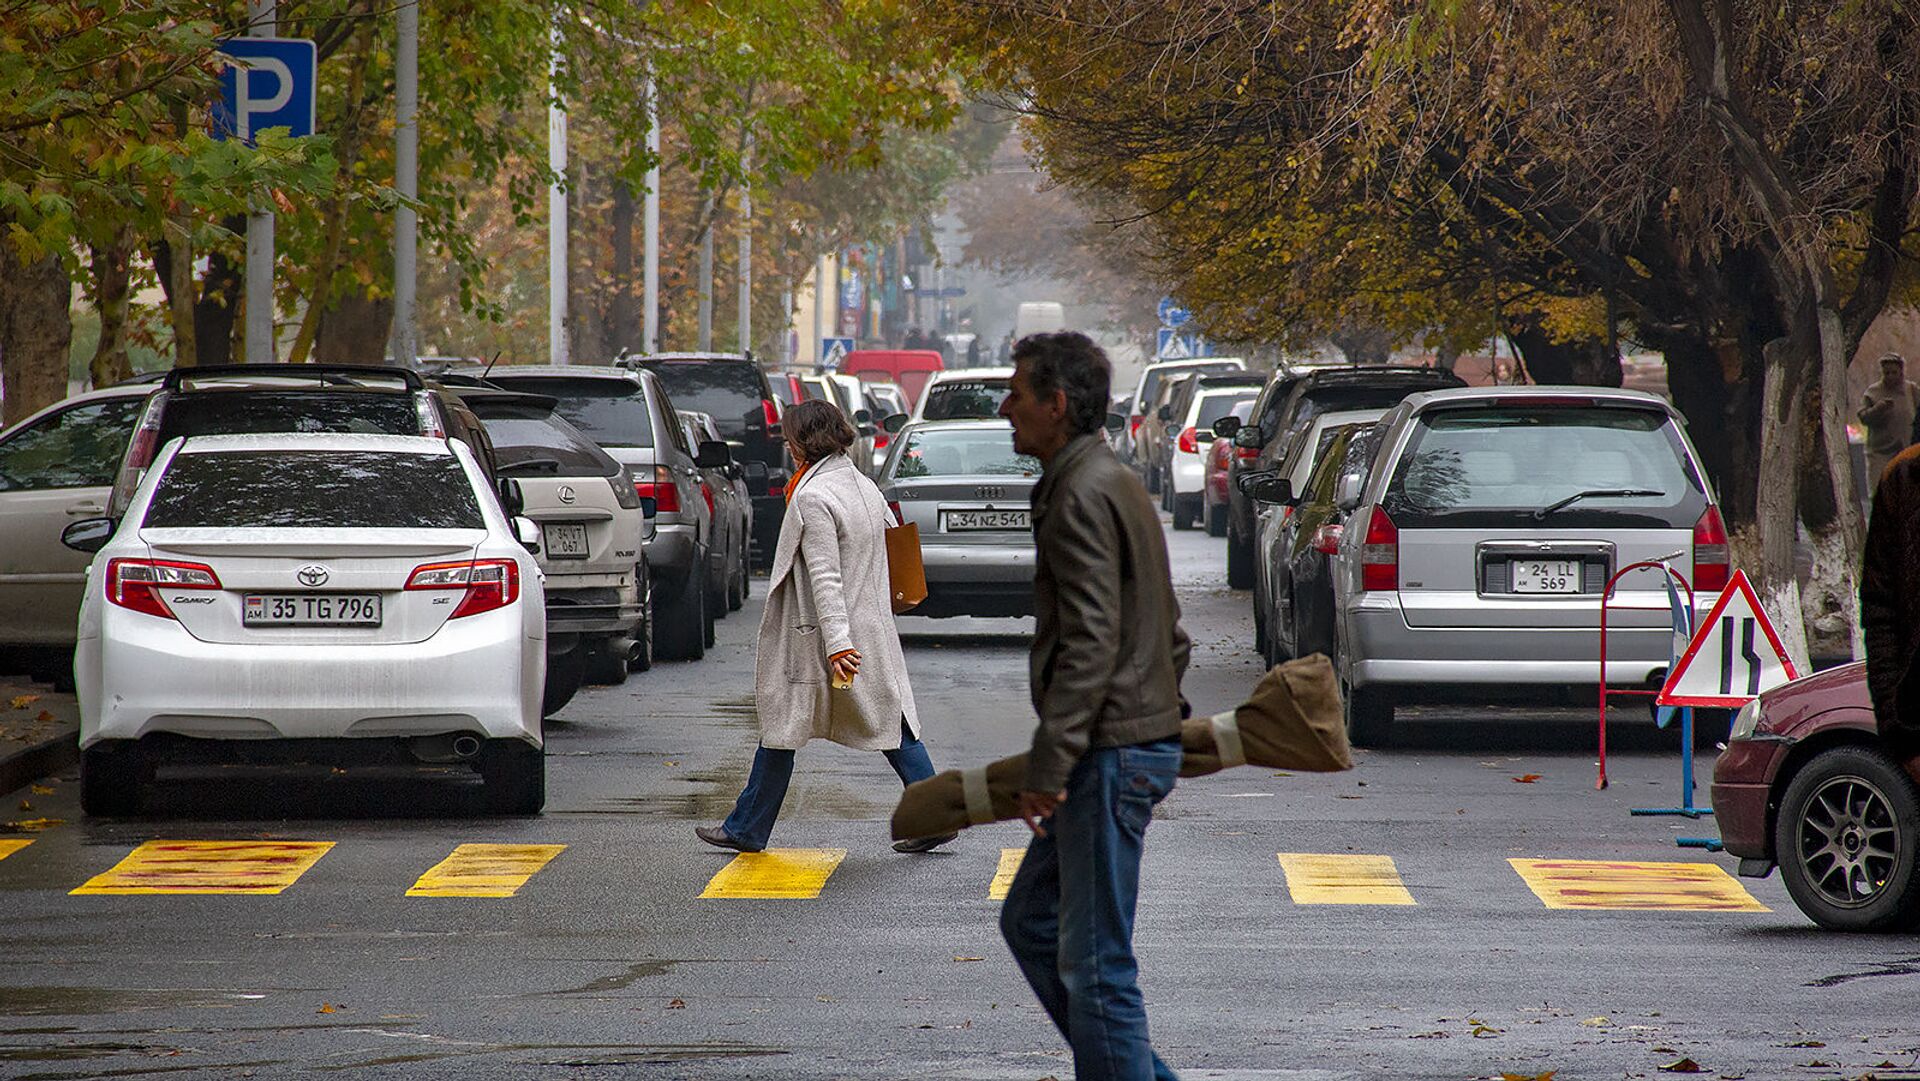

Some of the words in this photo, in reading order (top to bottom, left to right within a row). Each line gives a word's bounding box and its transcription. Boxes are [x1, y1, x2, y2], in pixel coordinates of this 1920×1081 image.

[236, 56, 293, 141] P
[960, 513, 977, 527] 34
[980, 515, 997, 527] NZ
[1000, 513, 1026, 526] 541
[1531, 564, 1549, 576] 24
[1558, 564, 1574, 576] LL
[1541, 577, 1566, 590] 569
[247, 610, 262, 619] AM
[272, 598, 296, 619] 35
[302, 598, 331, 619] TG
[338, 598, 374, 619] 796
